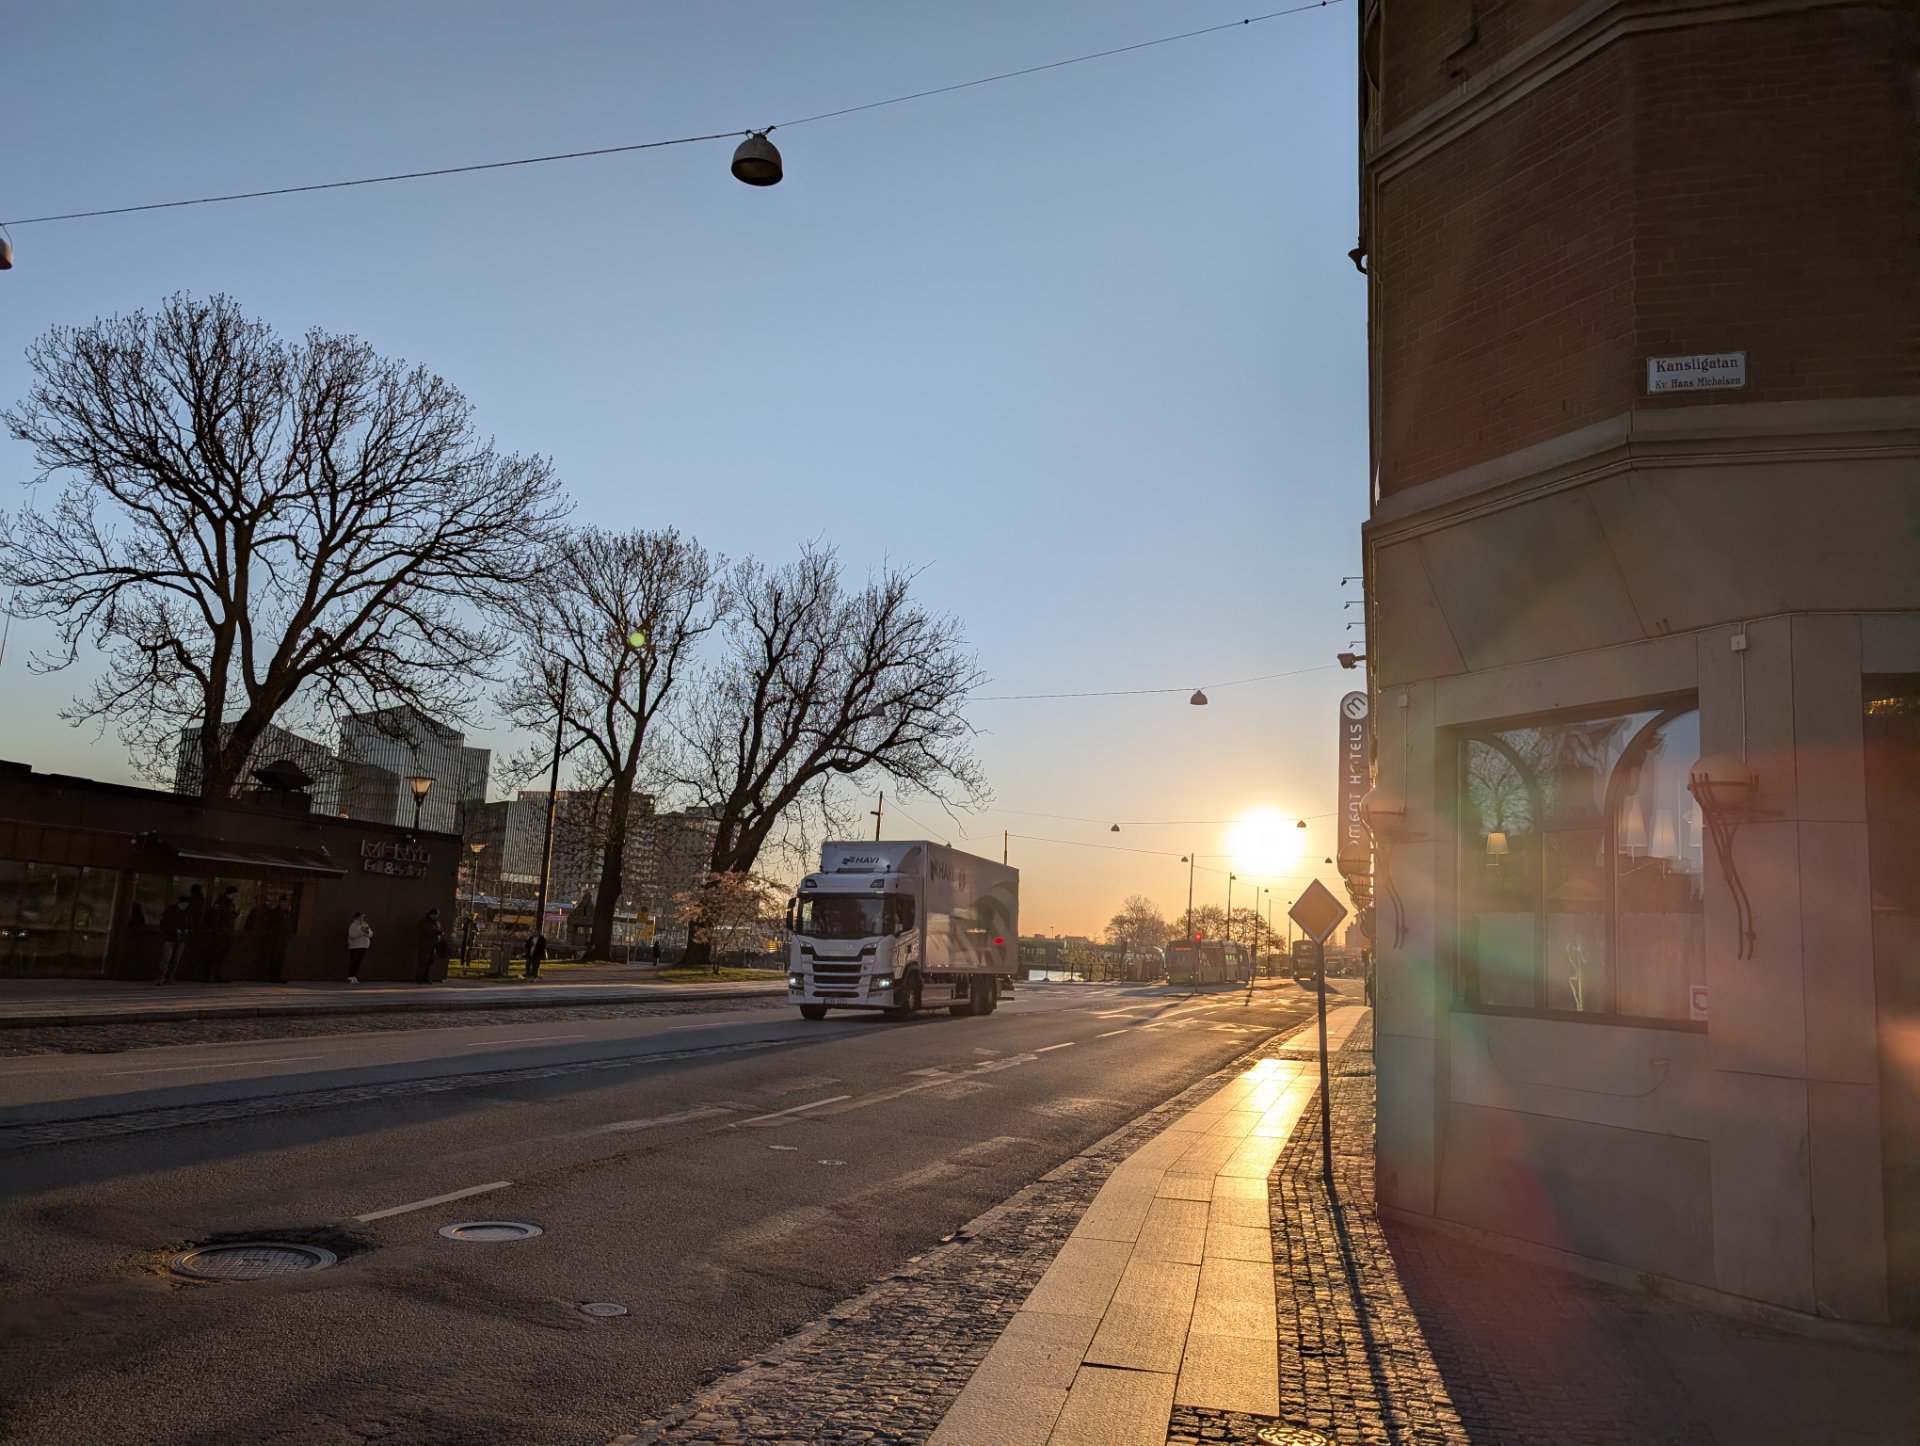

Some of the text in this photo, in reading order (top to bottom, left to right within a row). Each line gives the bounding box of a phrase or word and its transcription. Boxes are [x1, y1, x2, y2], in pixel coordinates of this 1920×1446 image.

[1656, 358, 1739, 373] Kansligatan
[1671, 378, 1694, 388] Hans
[1697, 376, 1741, 387] Michelsen
